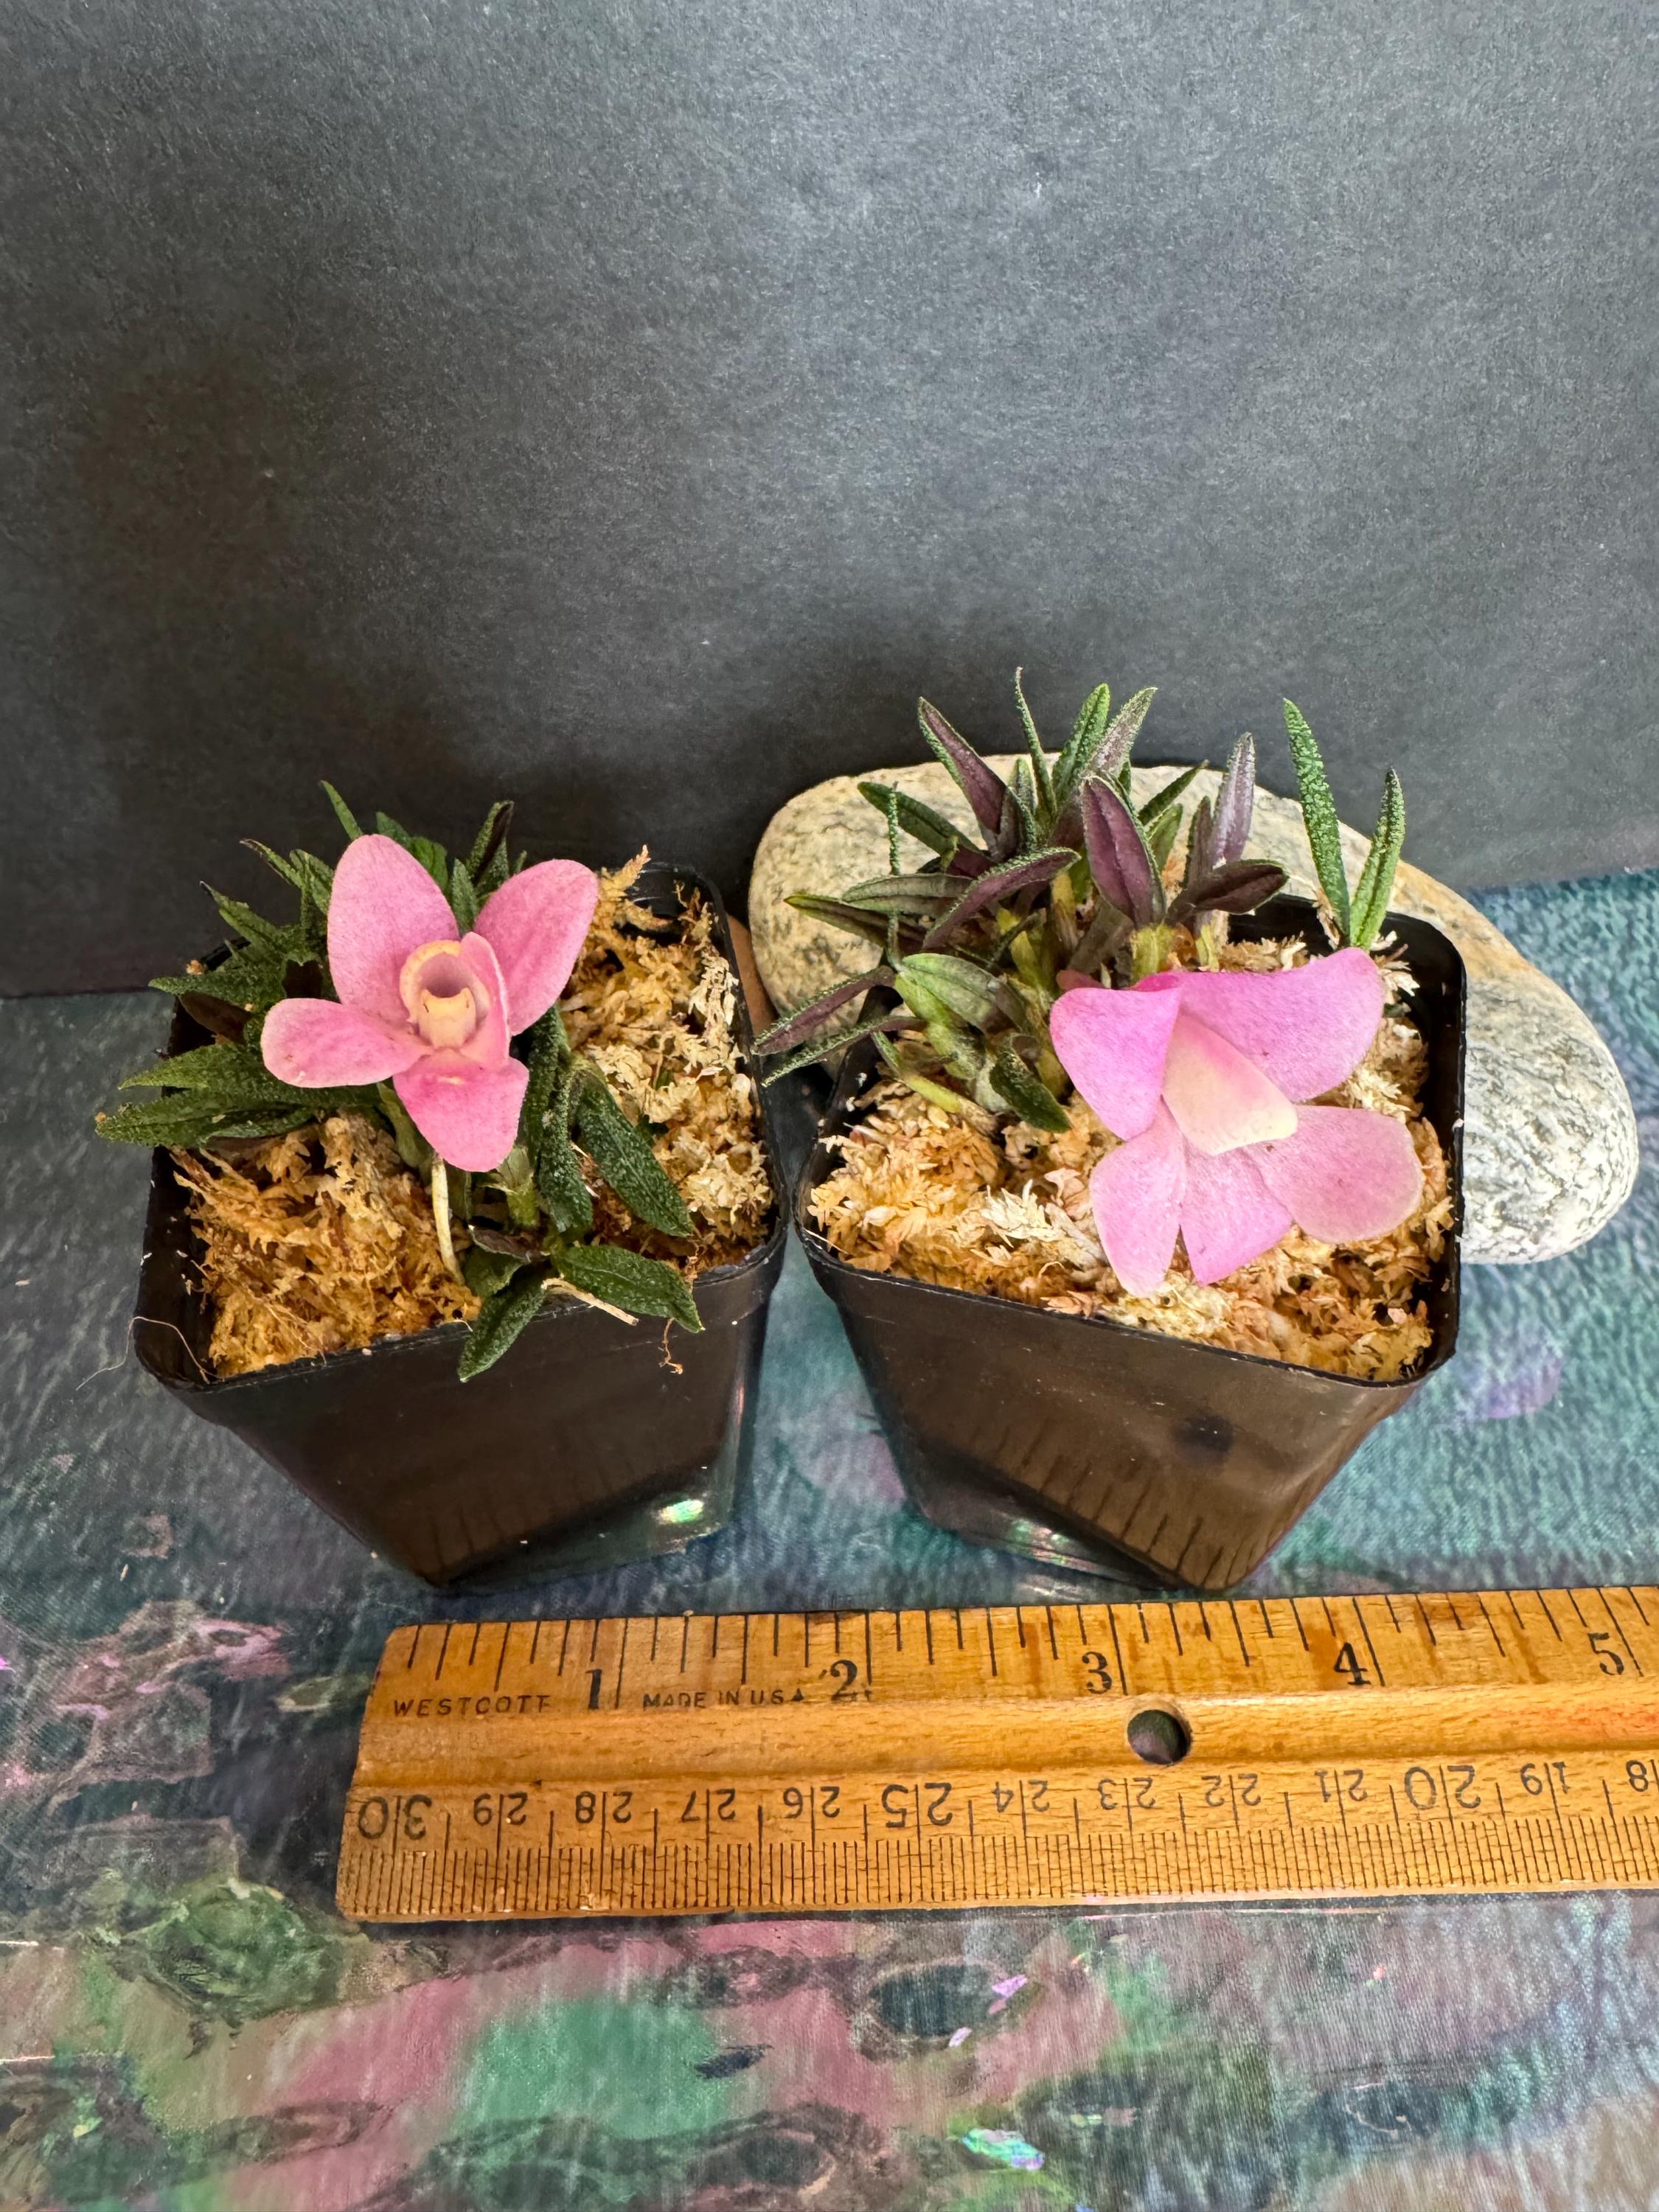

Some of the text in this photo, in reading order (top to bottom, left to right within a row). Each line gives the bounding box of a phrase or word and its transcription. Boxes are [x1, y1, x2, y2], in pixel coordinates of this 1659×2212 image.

[1333, 1643, 1371, 1685] 4
[1587, 1632, 1624, 1675] 5
[585, 1669, 602, 1709] 1
[830, 1659, 858, 1701] 2
[1082, 1652, 1113, 1694] 3
[394, 1696, 551, 1717] WESTCOTT
[643, 1691, 706, 1711] MADE
[718, 1690, 739, 1705] IN
[1202, 1773, 1261, 1807] 22
[1314, 1770, 1368, 1803] 21
[1404, 1765, 1481, 1809] 20
[1520, 1761, 1568, 1795] 19
[1625, 1759, 1649, 1792] 8
[473, 1792, 528, 1826] 29
[575, 1791, 633, 1823] 28
[681, 1788, 736, 1823] 27
[783, 1787, 841, 1818] 26
[882, 1782, 953, 1828] 25
[992, 1780, 1049, 1812] 24
[1097, 1778, 1155, 1810] 23
[358, 1794, 432, 1840] 30
